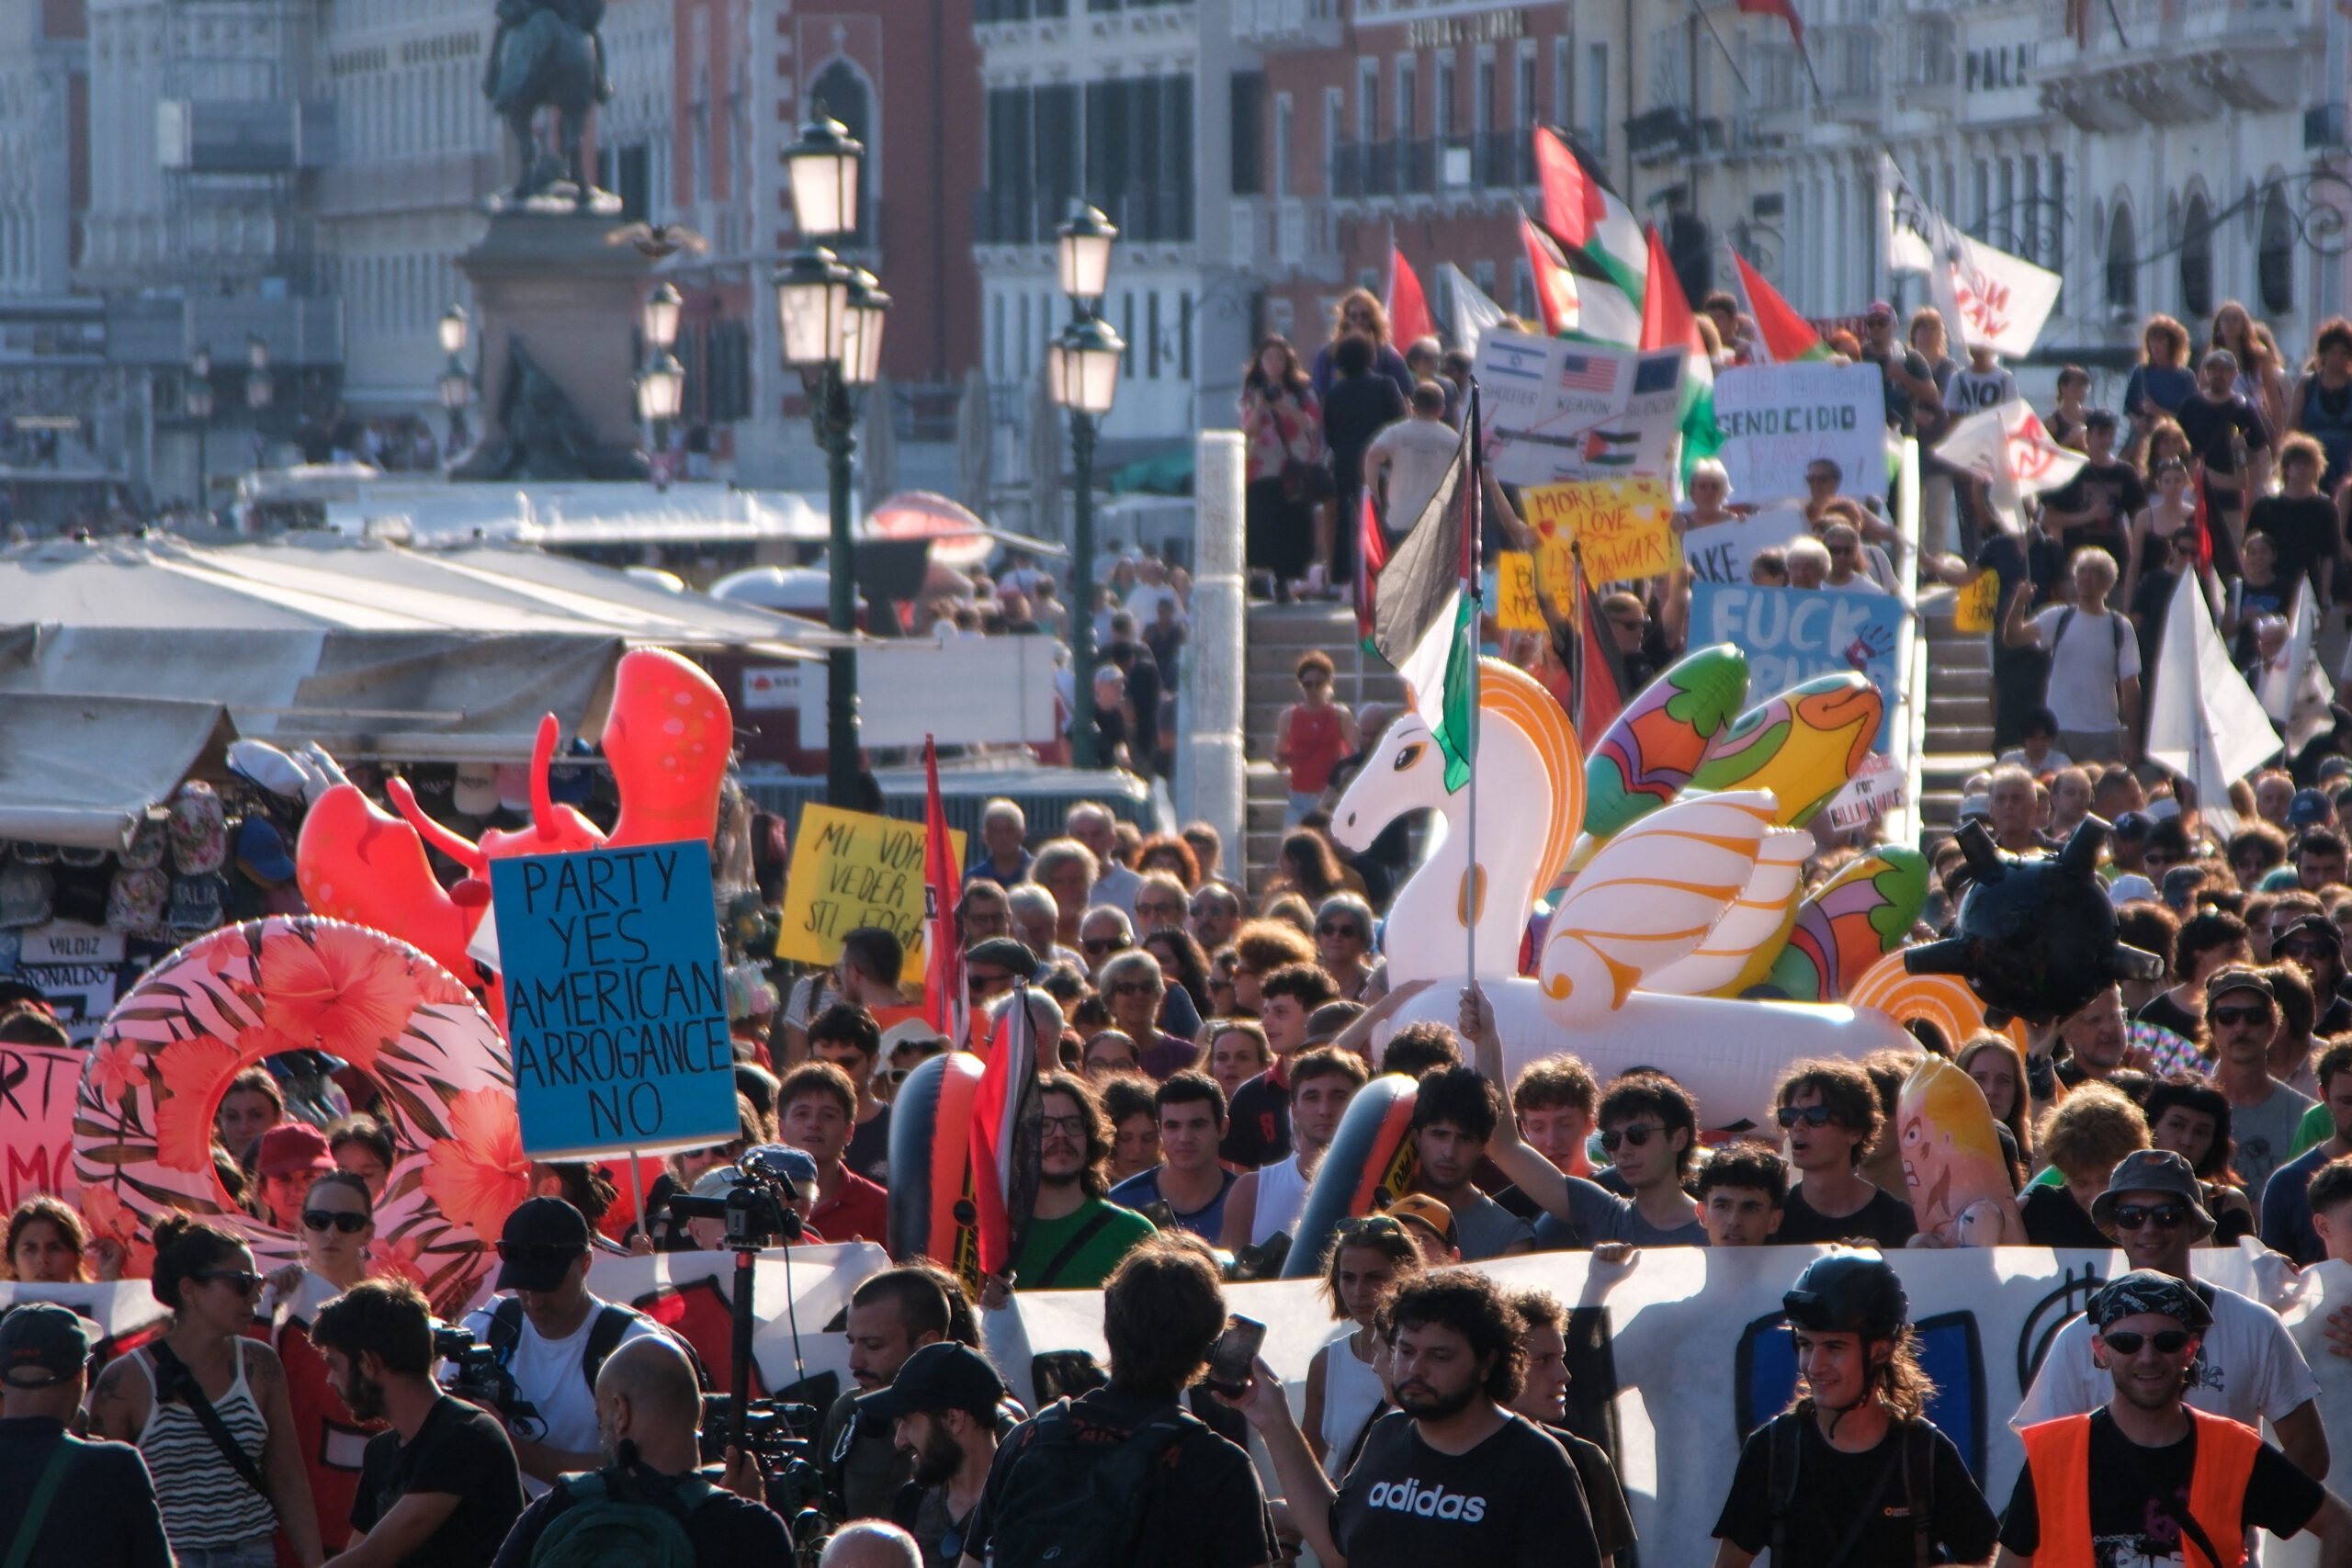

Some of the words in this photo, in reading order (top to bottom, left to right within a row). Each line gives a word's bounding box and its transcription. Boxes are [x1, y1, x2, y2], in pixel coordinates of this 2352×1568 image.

[1556, 396, 1612, 414] WEAPON
[1715, 405, 1857, 439] GENOCIDIO
[1535, 487, 1602, 517] MORE
[1578, 504, 1634, 536] LOVE
[1690, 542, 1743, 584] AKE
[1713, 589, 1871, 659] FUCK
[814, 820, 856, 858] MI
[523, 851, 677, 914] PARTY
[830, 863, 908, 908] VEDER
[548, 908, 649, 968] YES
[804, 899, 840, 939] STI
[21, 965, 108, 987] RONALDO
[509, 960, 724, 1032] AMERICAN
[516, 1016, 731, 1089] ARROGANCE
[588, 1081, 663, 1138] NO
[1369, 1477, 1487, 1522] adidas
